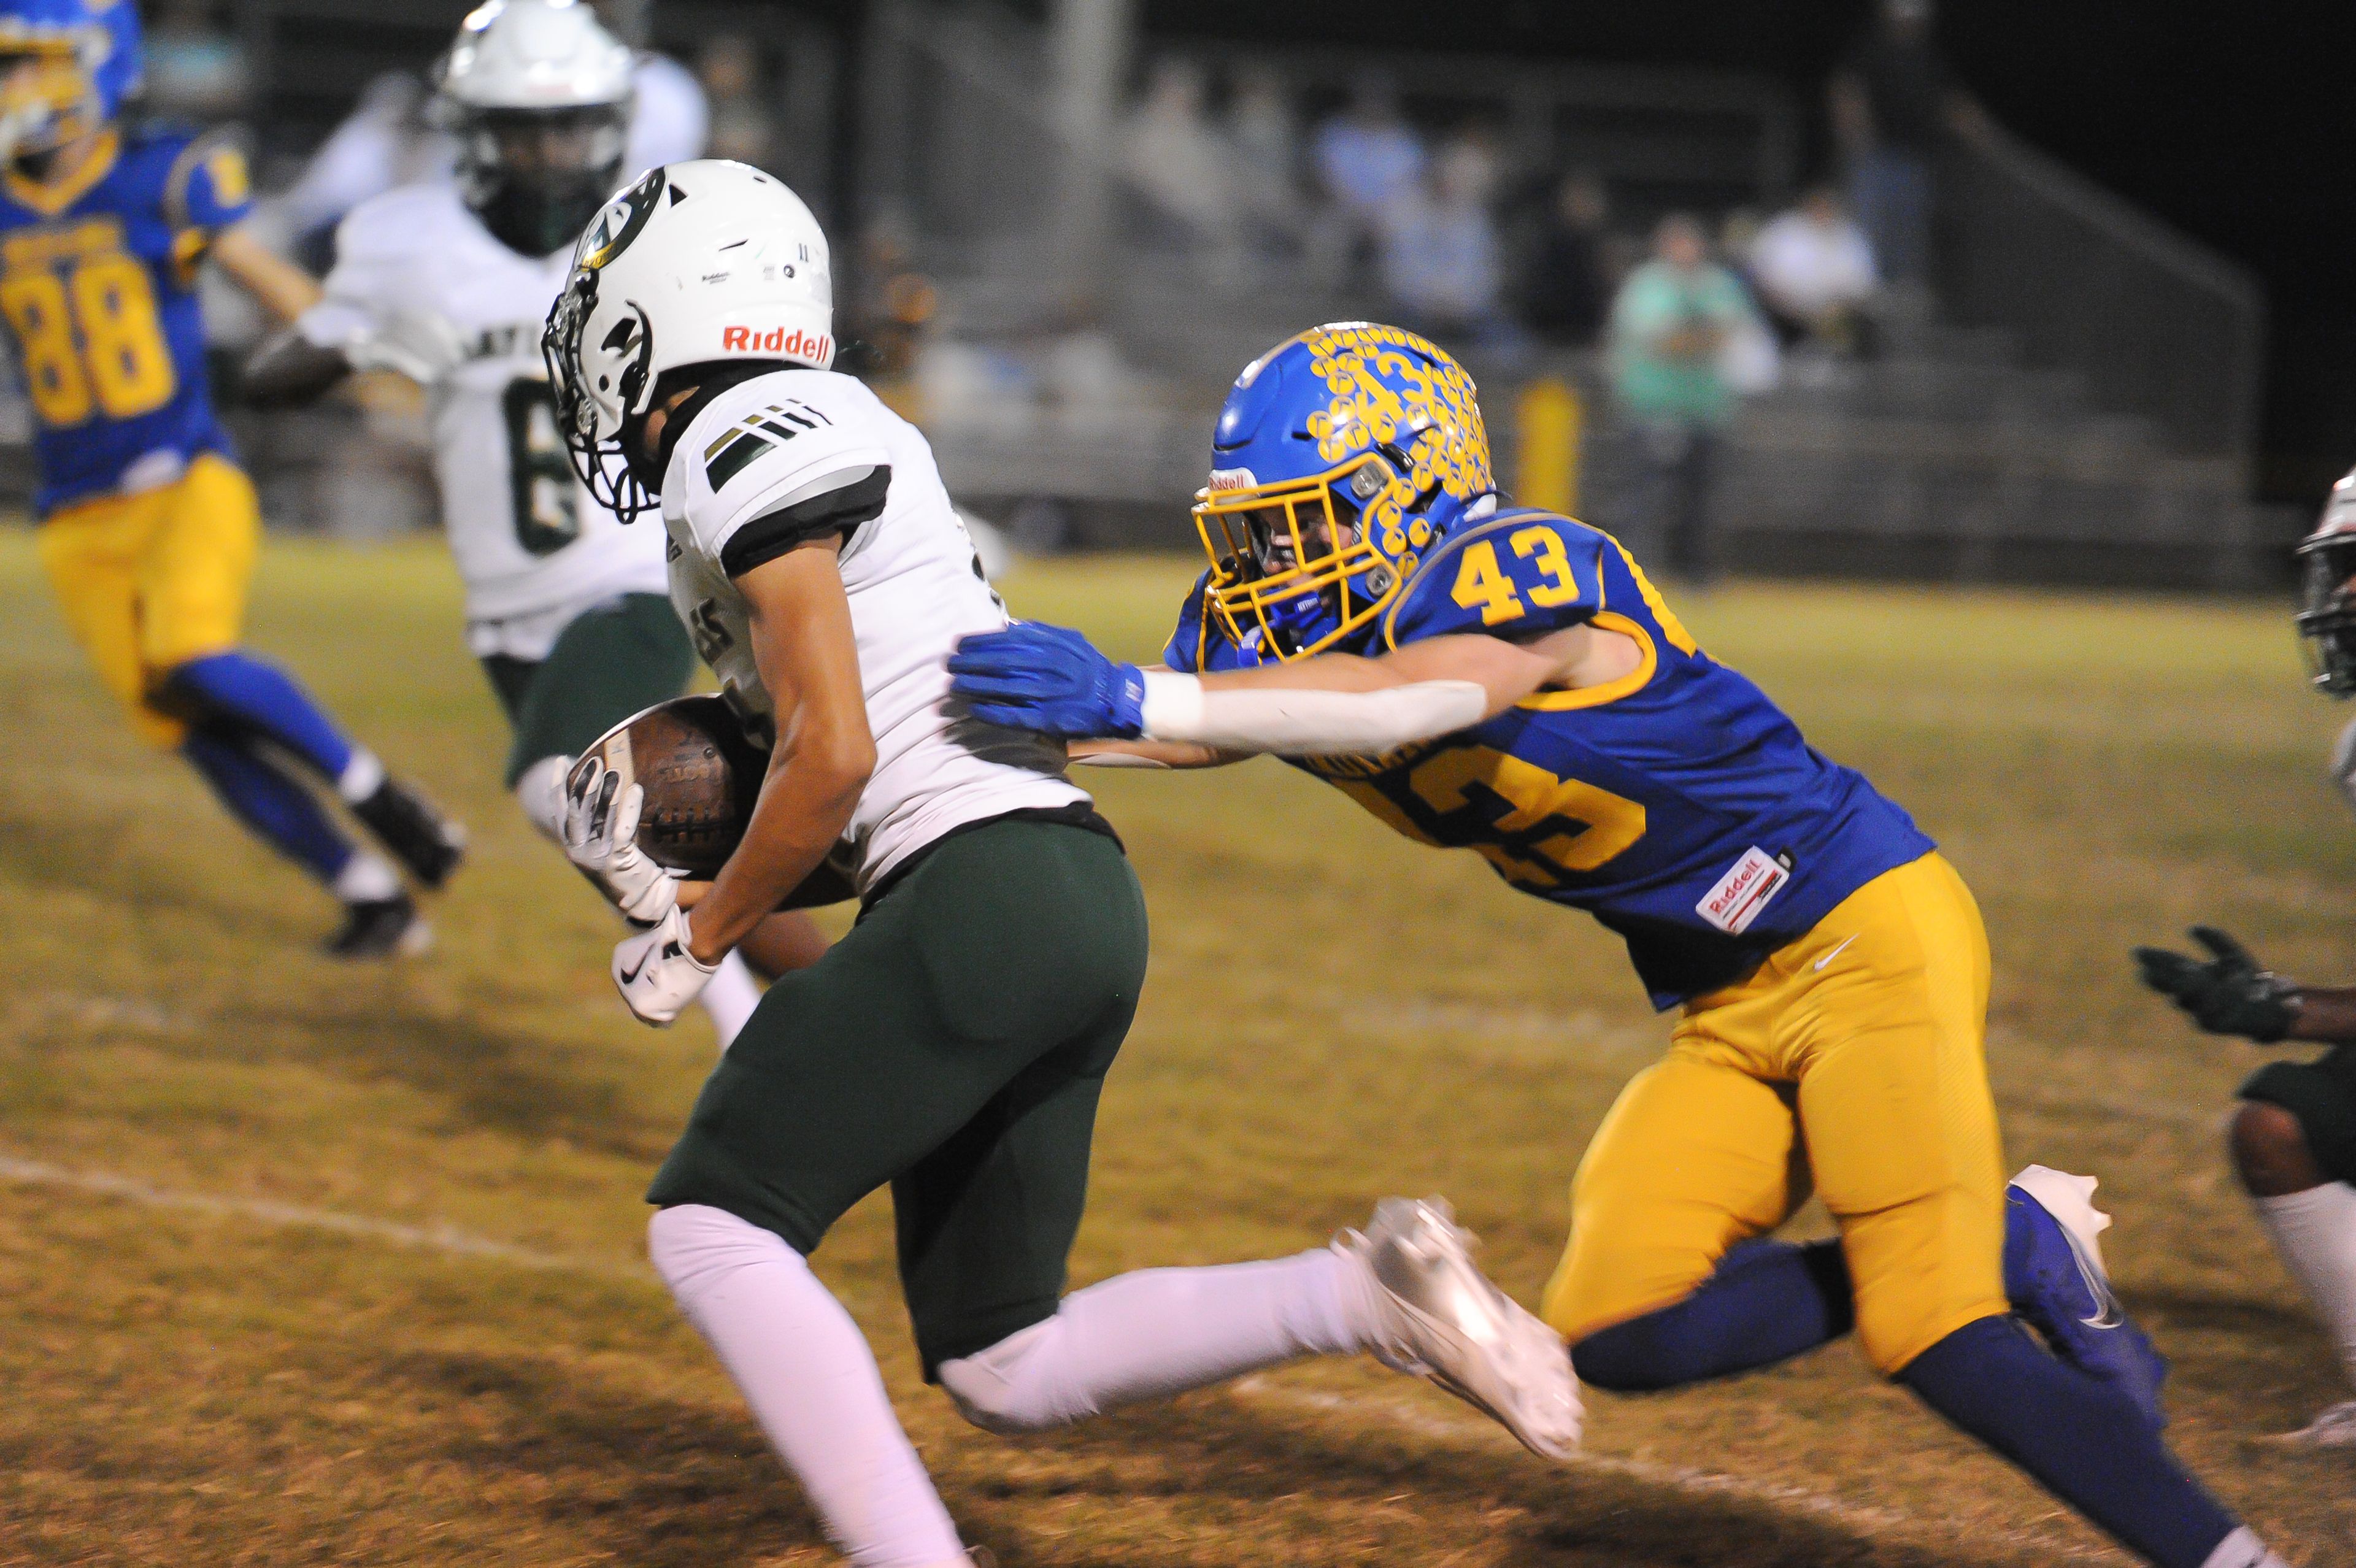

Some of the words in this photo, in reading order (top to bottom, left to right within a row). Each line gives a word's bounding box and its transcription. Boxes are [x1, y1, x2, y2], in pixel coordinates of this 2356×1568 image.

[0, 265, 175, 423] 88
[723, 326, 829, 363] Riddell
[1353, 352, 1434, 426] 43
[1450, 525, 1580, 627] 43
[1709, 859, 1762, 915] Riddell
